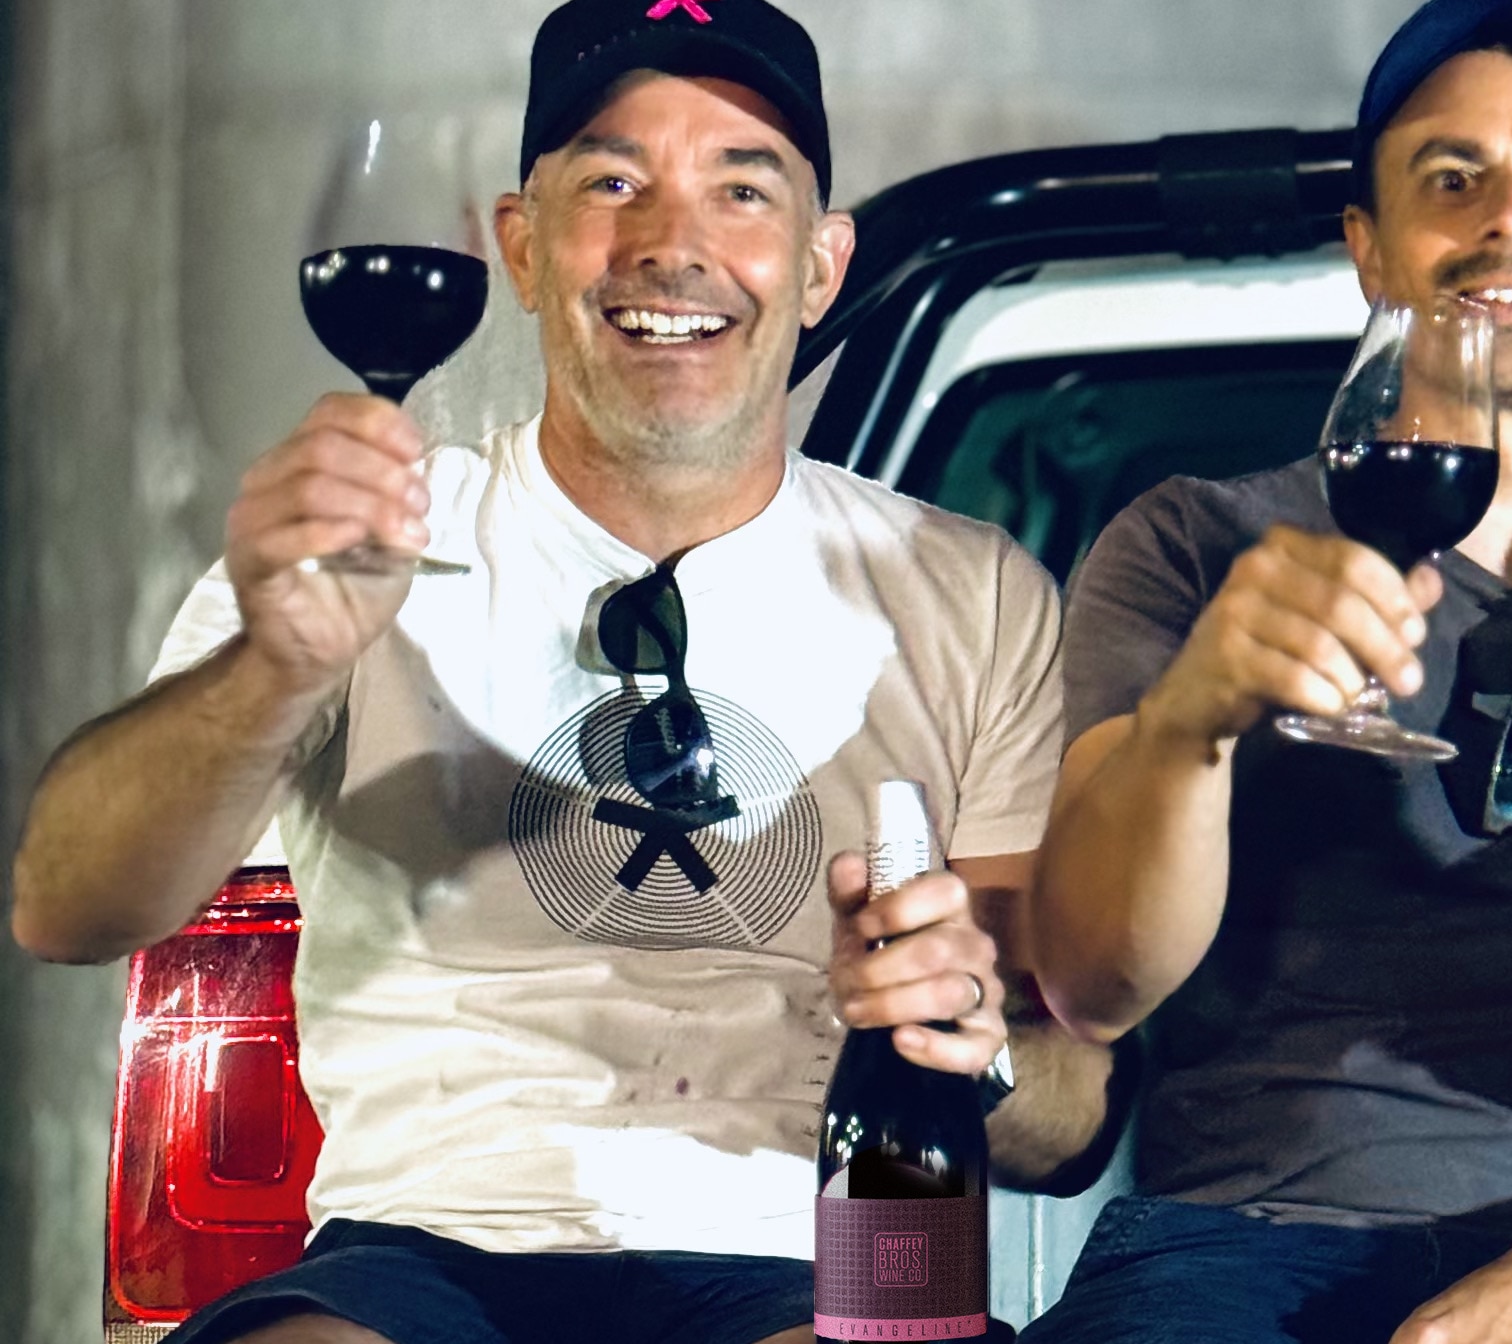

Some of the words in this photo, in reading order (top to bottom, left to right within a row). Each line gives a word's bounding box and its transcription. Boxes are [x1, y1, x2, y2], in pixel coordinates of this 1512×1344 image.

[879, 1237, 923, 1251] CHAFFEY
[879, 1250, 923, 1269] BROS.
[880, 1269, 906, 1282] WINE
